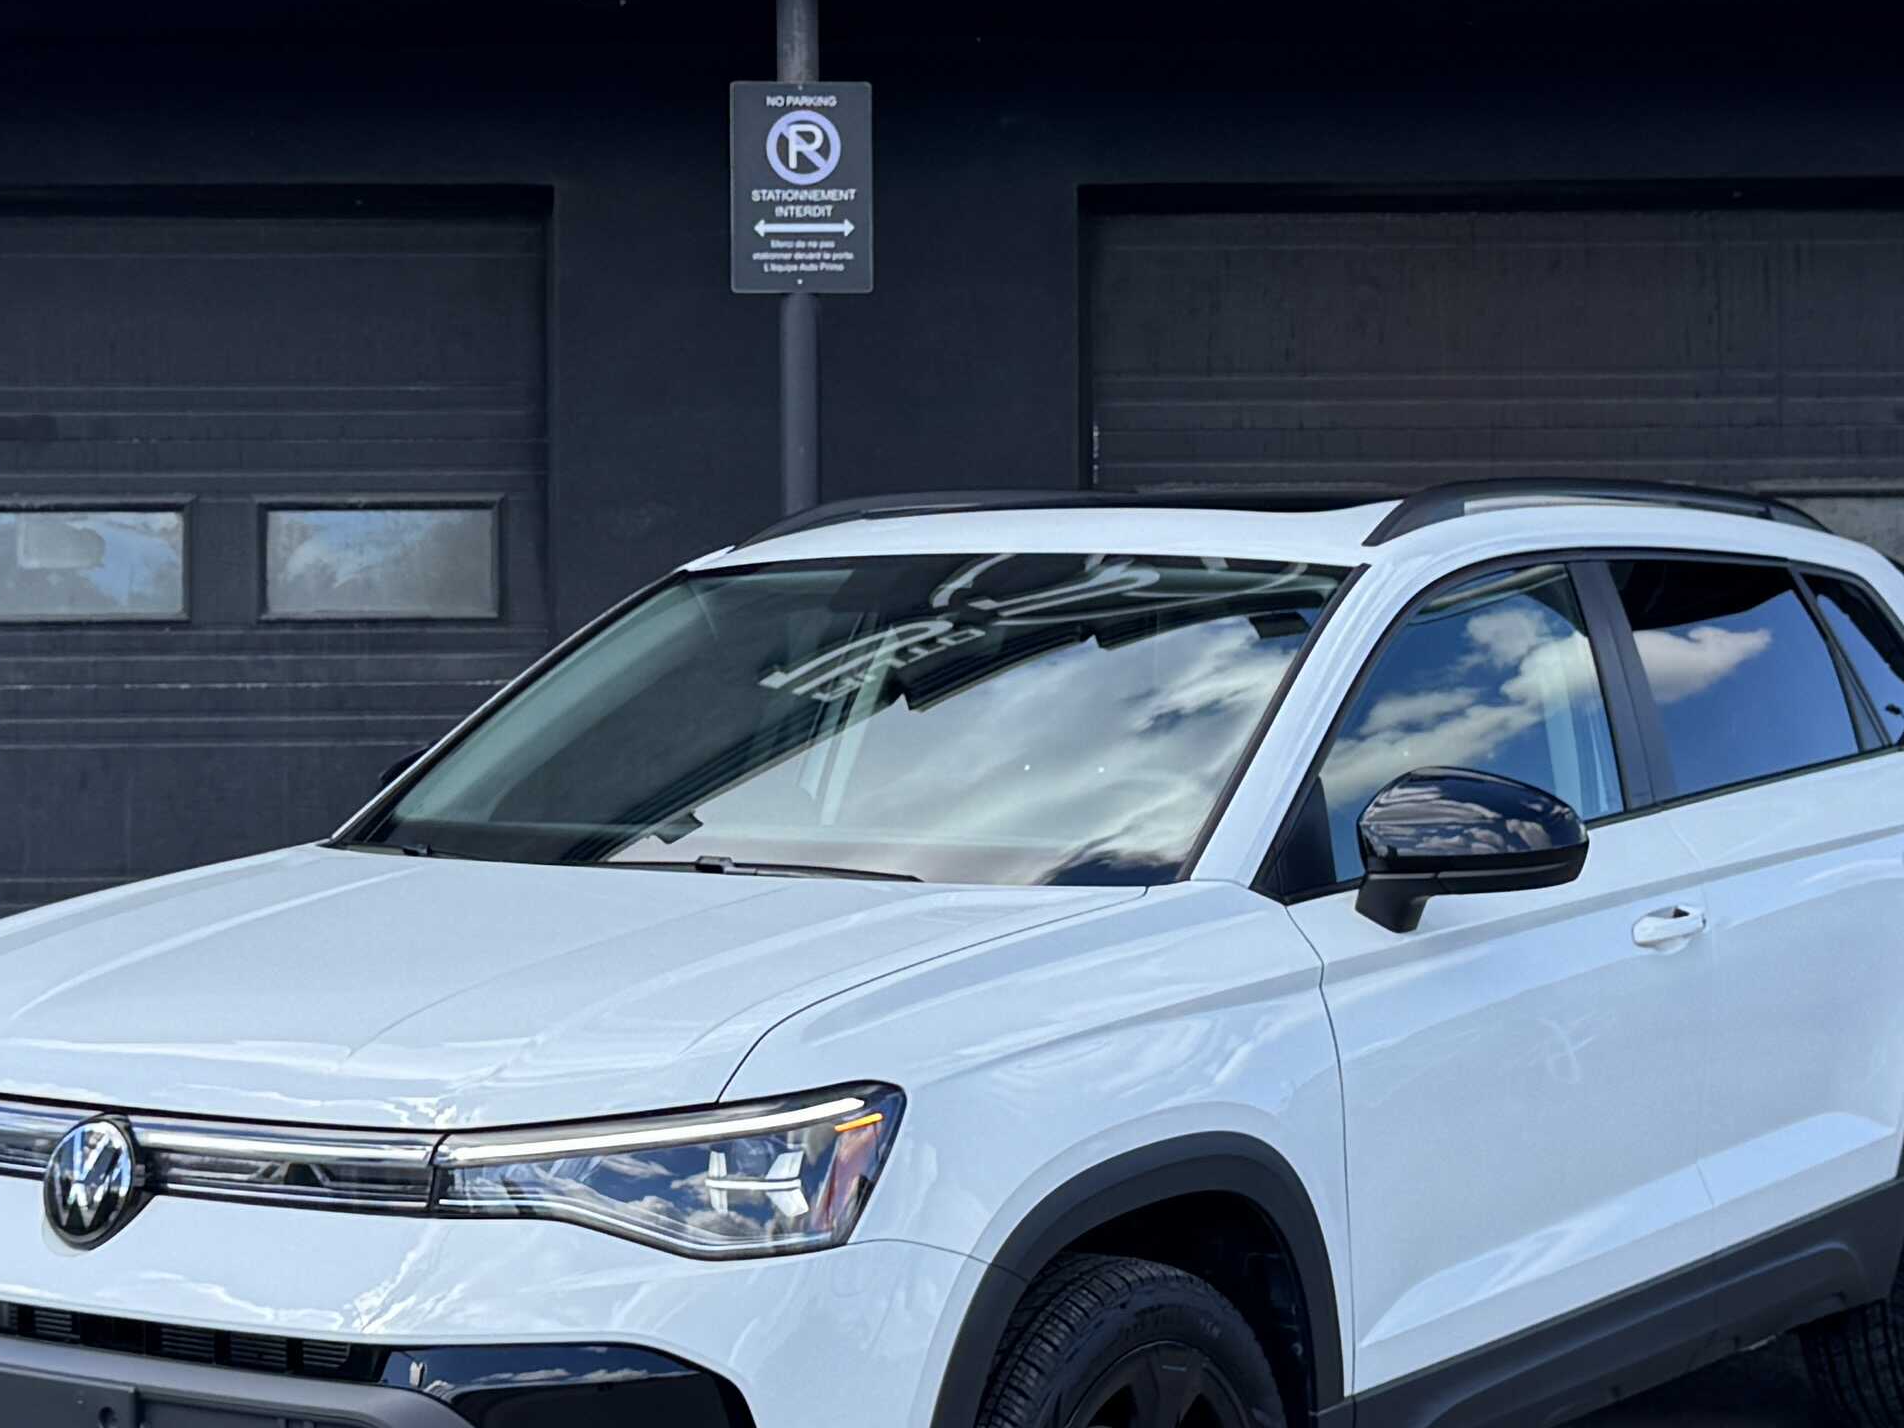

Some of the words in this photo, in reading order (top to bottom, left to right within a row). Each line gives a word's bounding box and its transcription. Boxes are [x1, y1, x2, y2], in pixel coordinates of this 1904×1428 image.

[766, 95, 785, 107] NO
[786, 95, 837, 107] PARKING
[751, 189, 856, 202] STATIONNEMENT
[775, 205, 833, 217] INTERDIT
